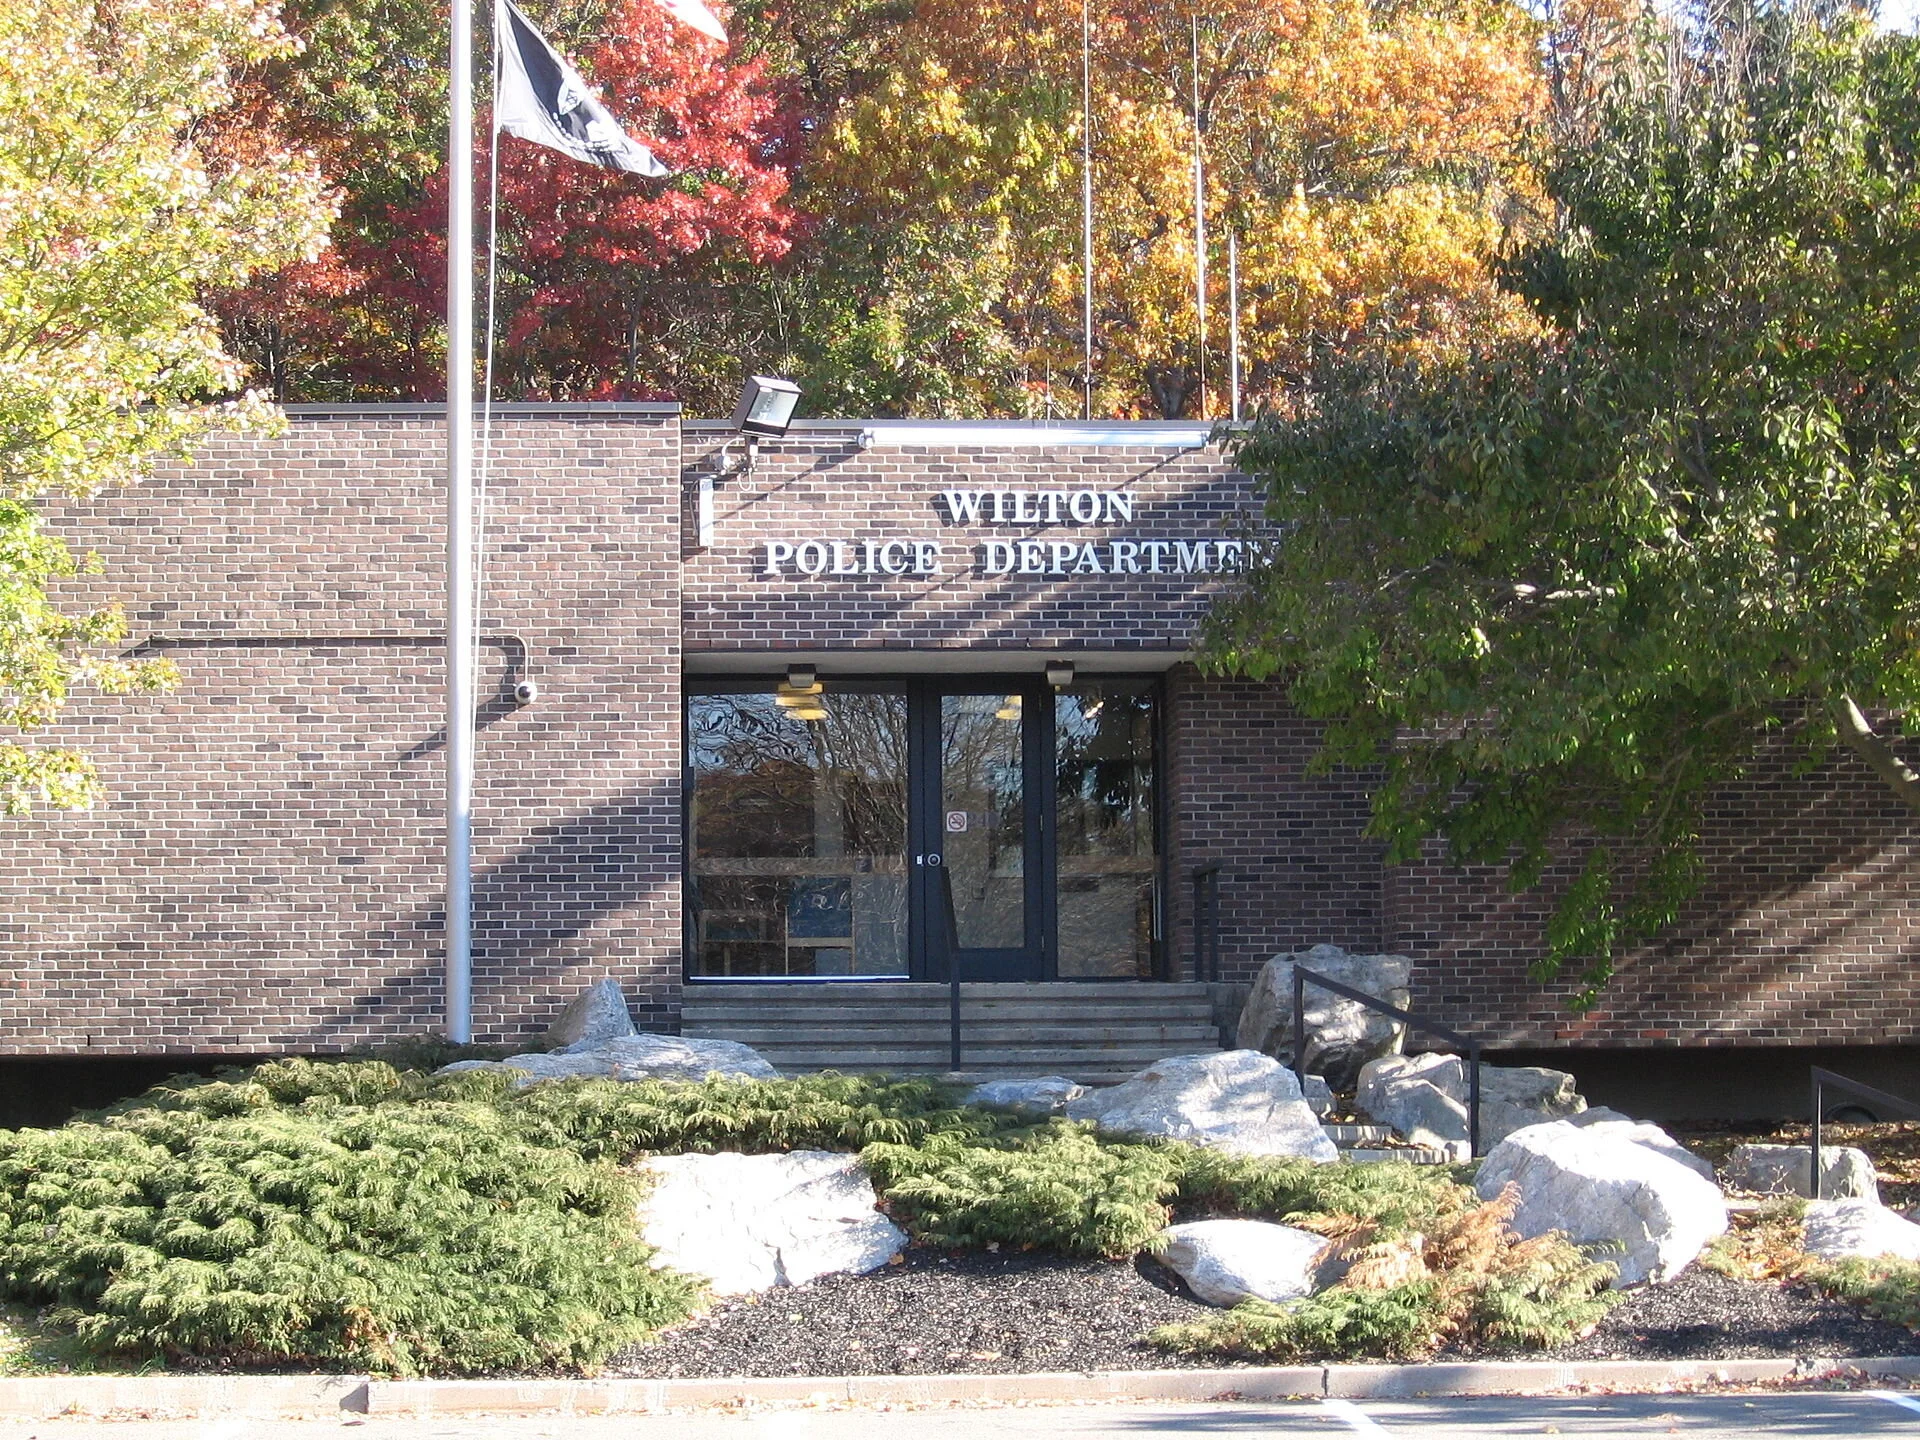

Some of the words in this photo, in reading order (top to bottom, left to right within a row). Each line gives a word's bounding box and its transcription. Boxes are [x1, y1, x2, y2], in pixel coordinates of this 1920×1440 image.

[942, 489, 1135, 523] WILTON
[762, 541, 942, 575] POLICE
[982, 541, 1281, 575] DEPARTMEN
